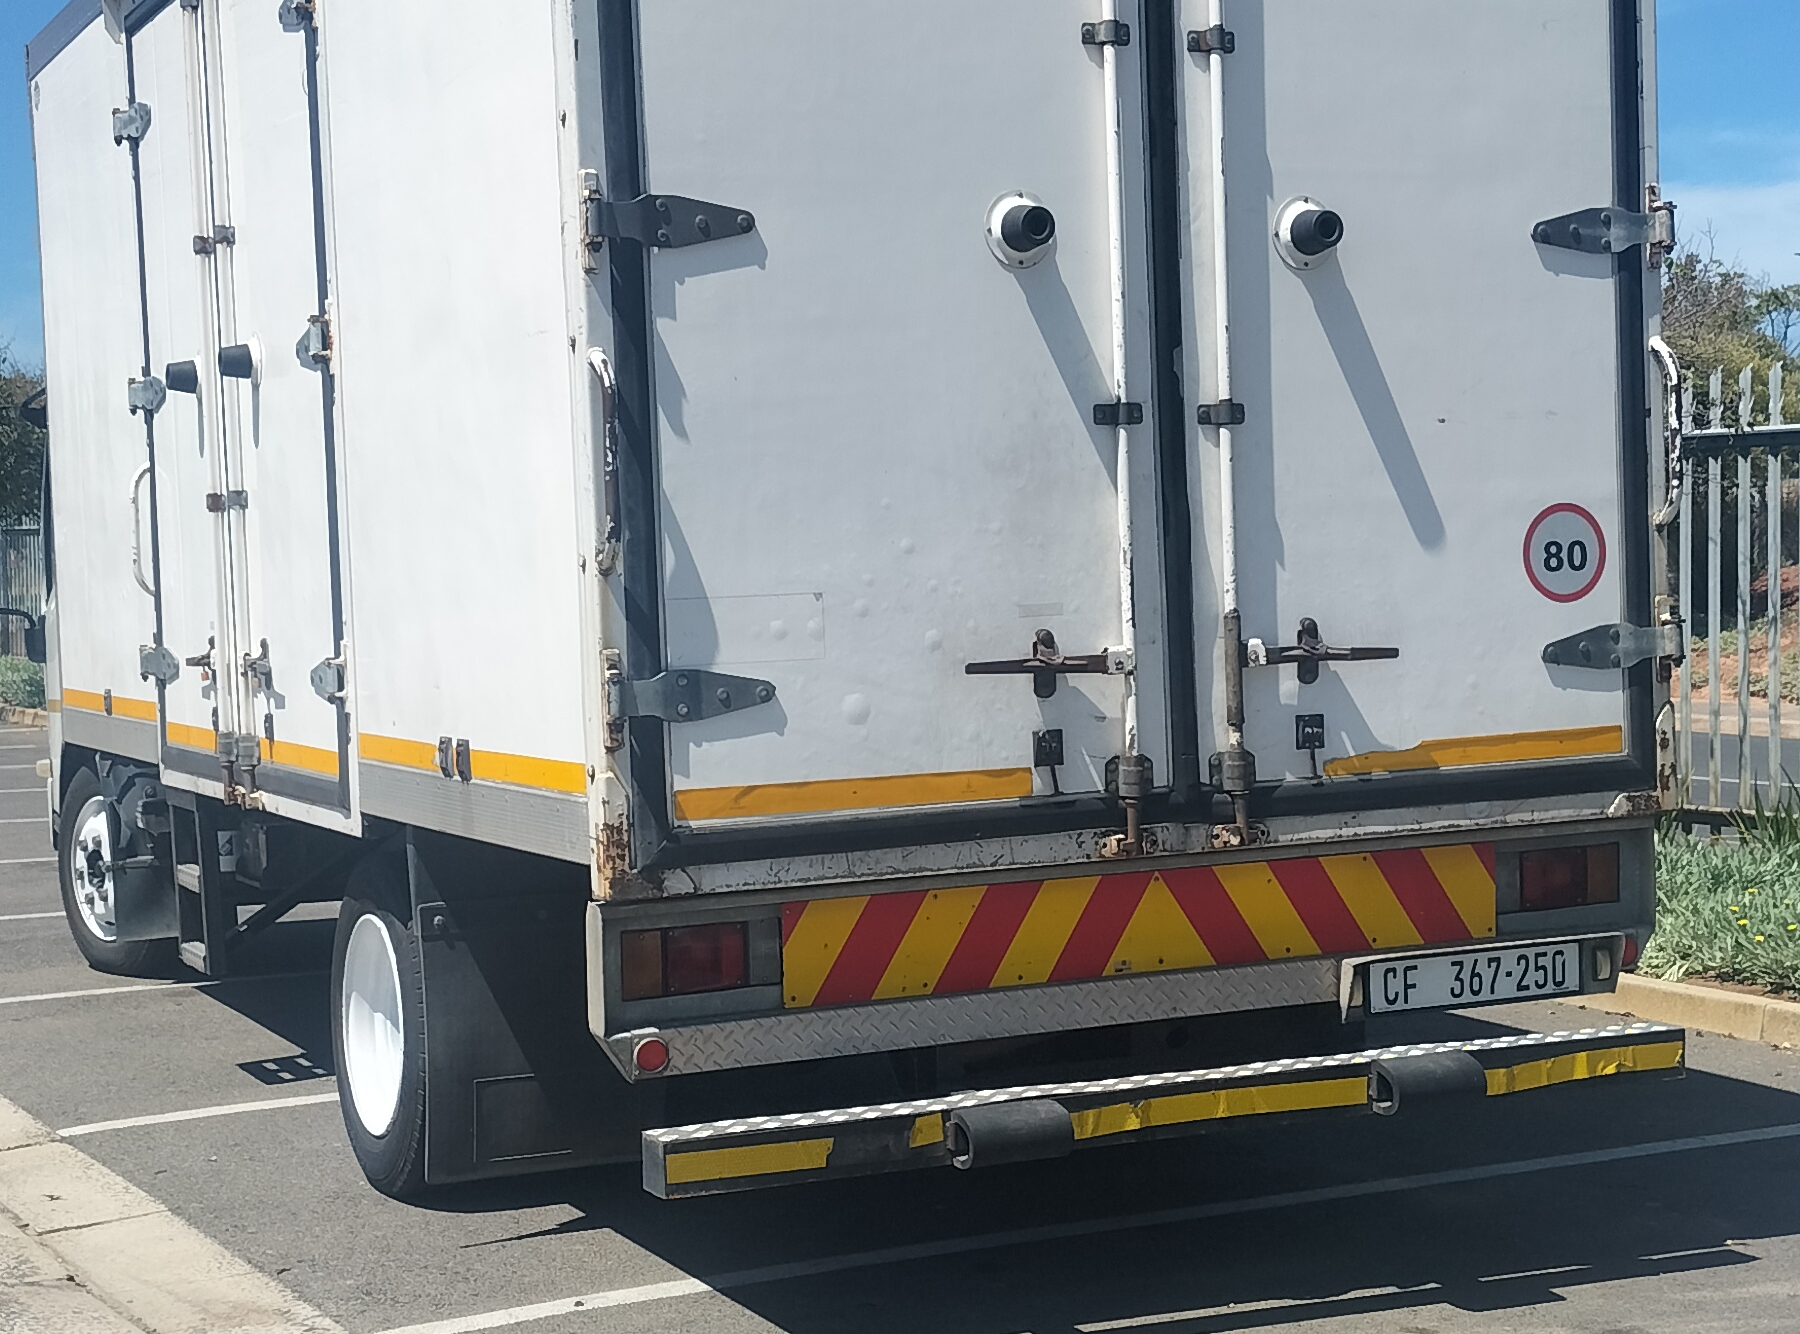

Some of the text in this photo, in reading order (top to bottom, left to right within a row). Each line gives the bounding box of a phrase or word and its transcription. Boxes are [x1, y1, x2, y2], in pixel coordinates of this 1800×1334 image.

[1543, 539, 1588, 573] 80
[1383, 949, 1566, 1006] CF 367-250
